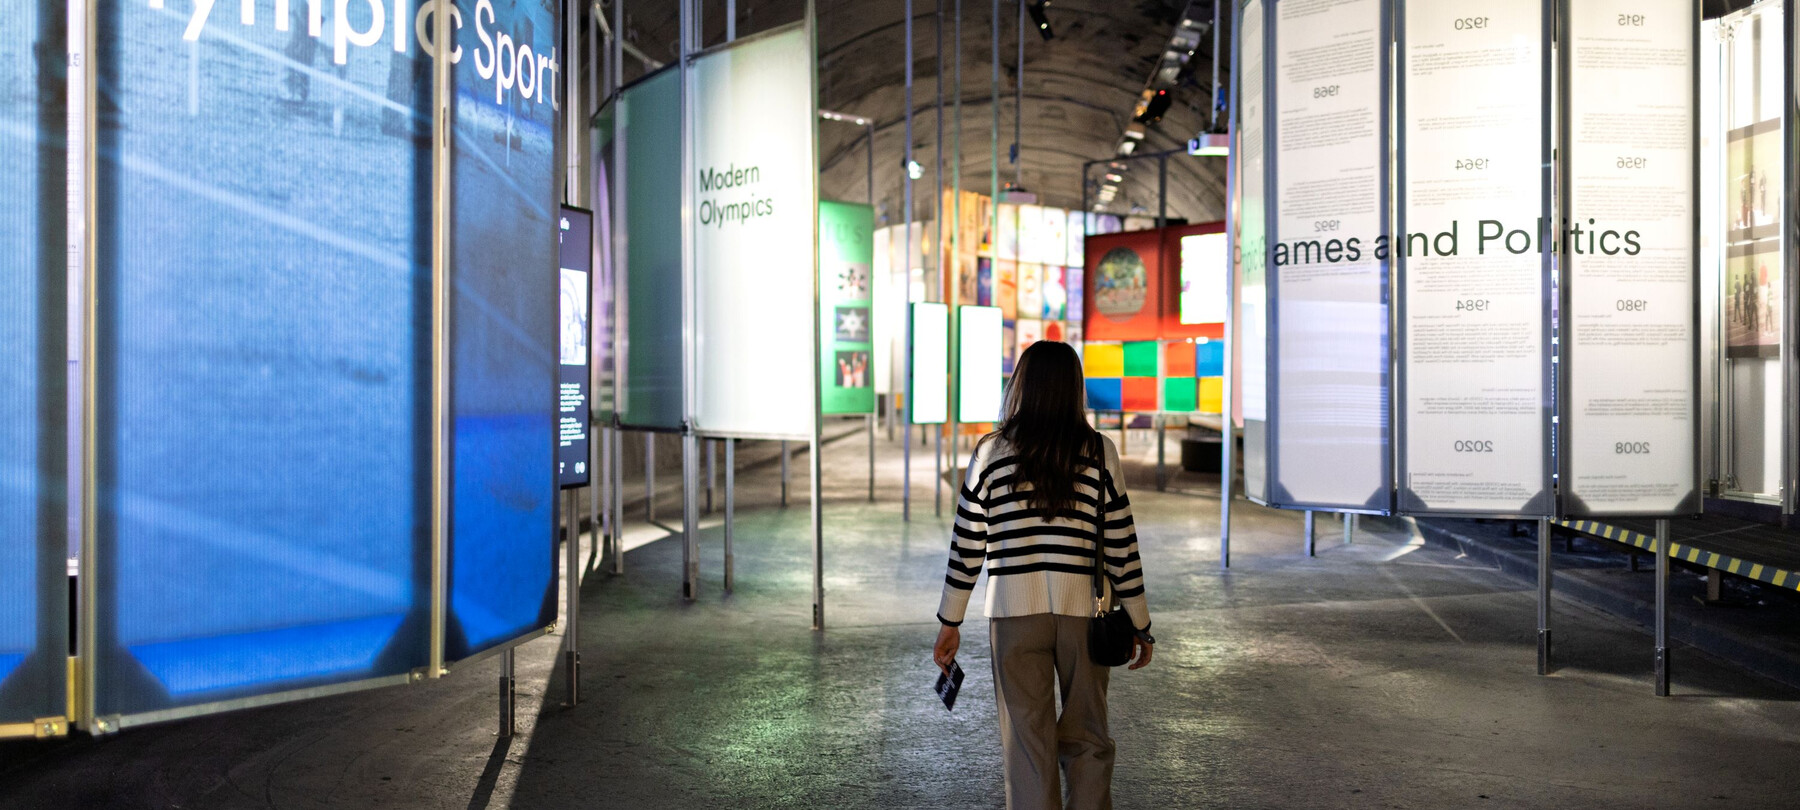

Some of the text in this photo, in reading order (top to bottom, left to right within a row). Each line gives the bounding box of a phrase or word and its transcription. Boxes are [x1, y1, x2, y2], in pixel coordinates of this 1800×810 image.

[149, 0, 560, 112] ympic Sport
[700, 163, 760, 192] Modern
[700, 194, 773, 229] Olympics
[1374, 220, 1458, 260] and
[1478, 217, 1641, 257] Politics
